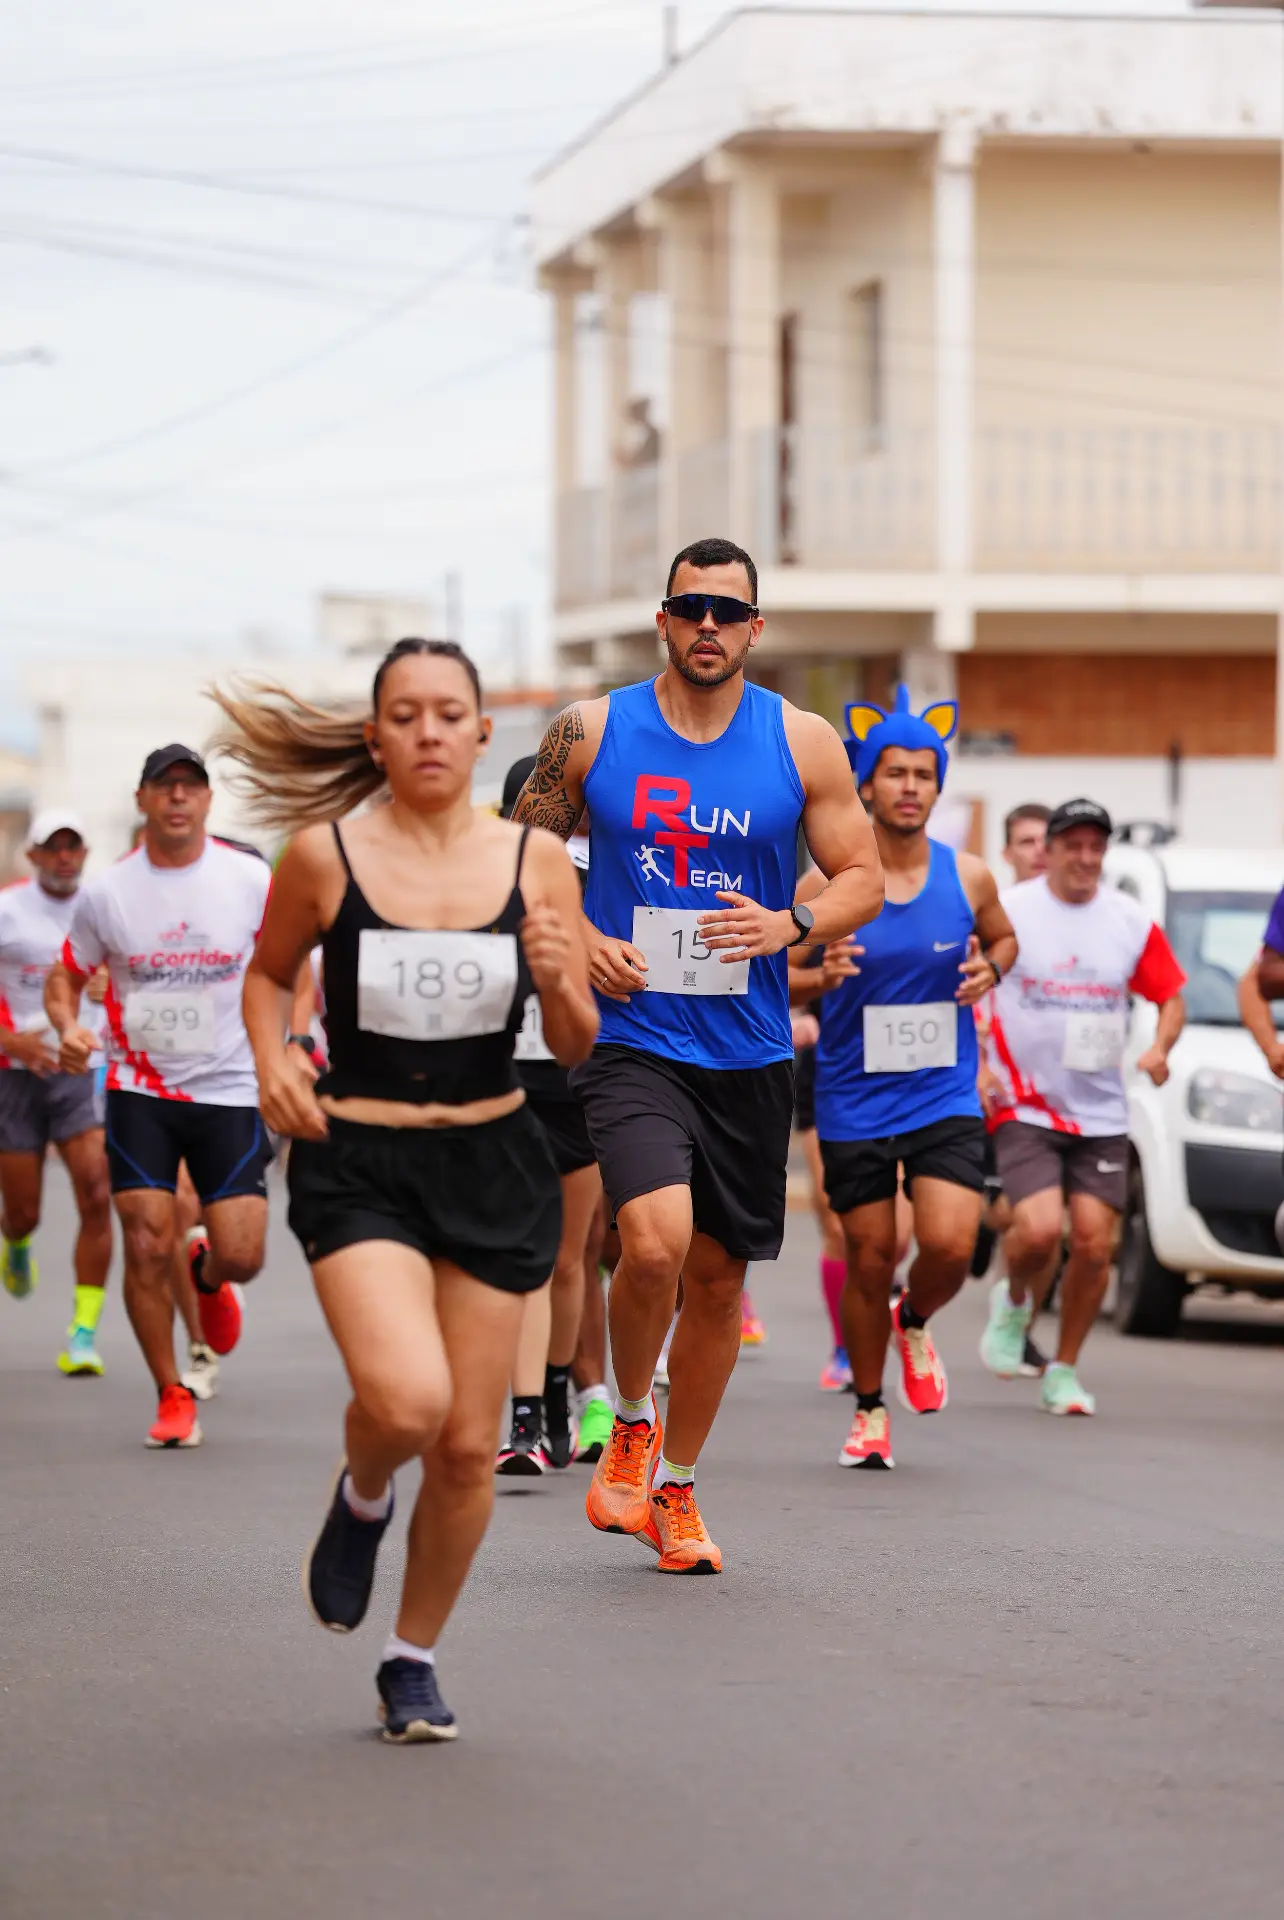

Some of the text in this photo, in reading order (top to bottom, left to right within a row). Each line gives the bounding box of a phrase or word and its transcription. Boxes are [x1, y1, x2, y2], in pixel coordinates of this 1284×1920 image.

[391, 957, 484, 1000] 189
[142, 1004, 200, 1031] 299
[883, 1020, 940, 1047] 150
